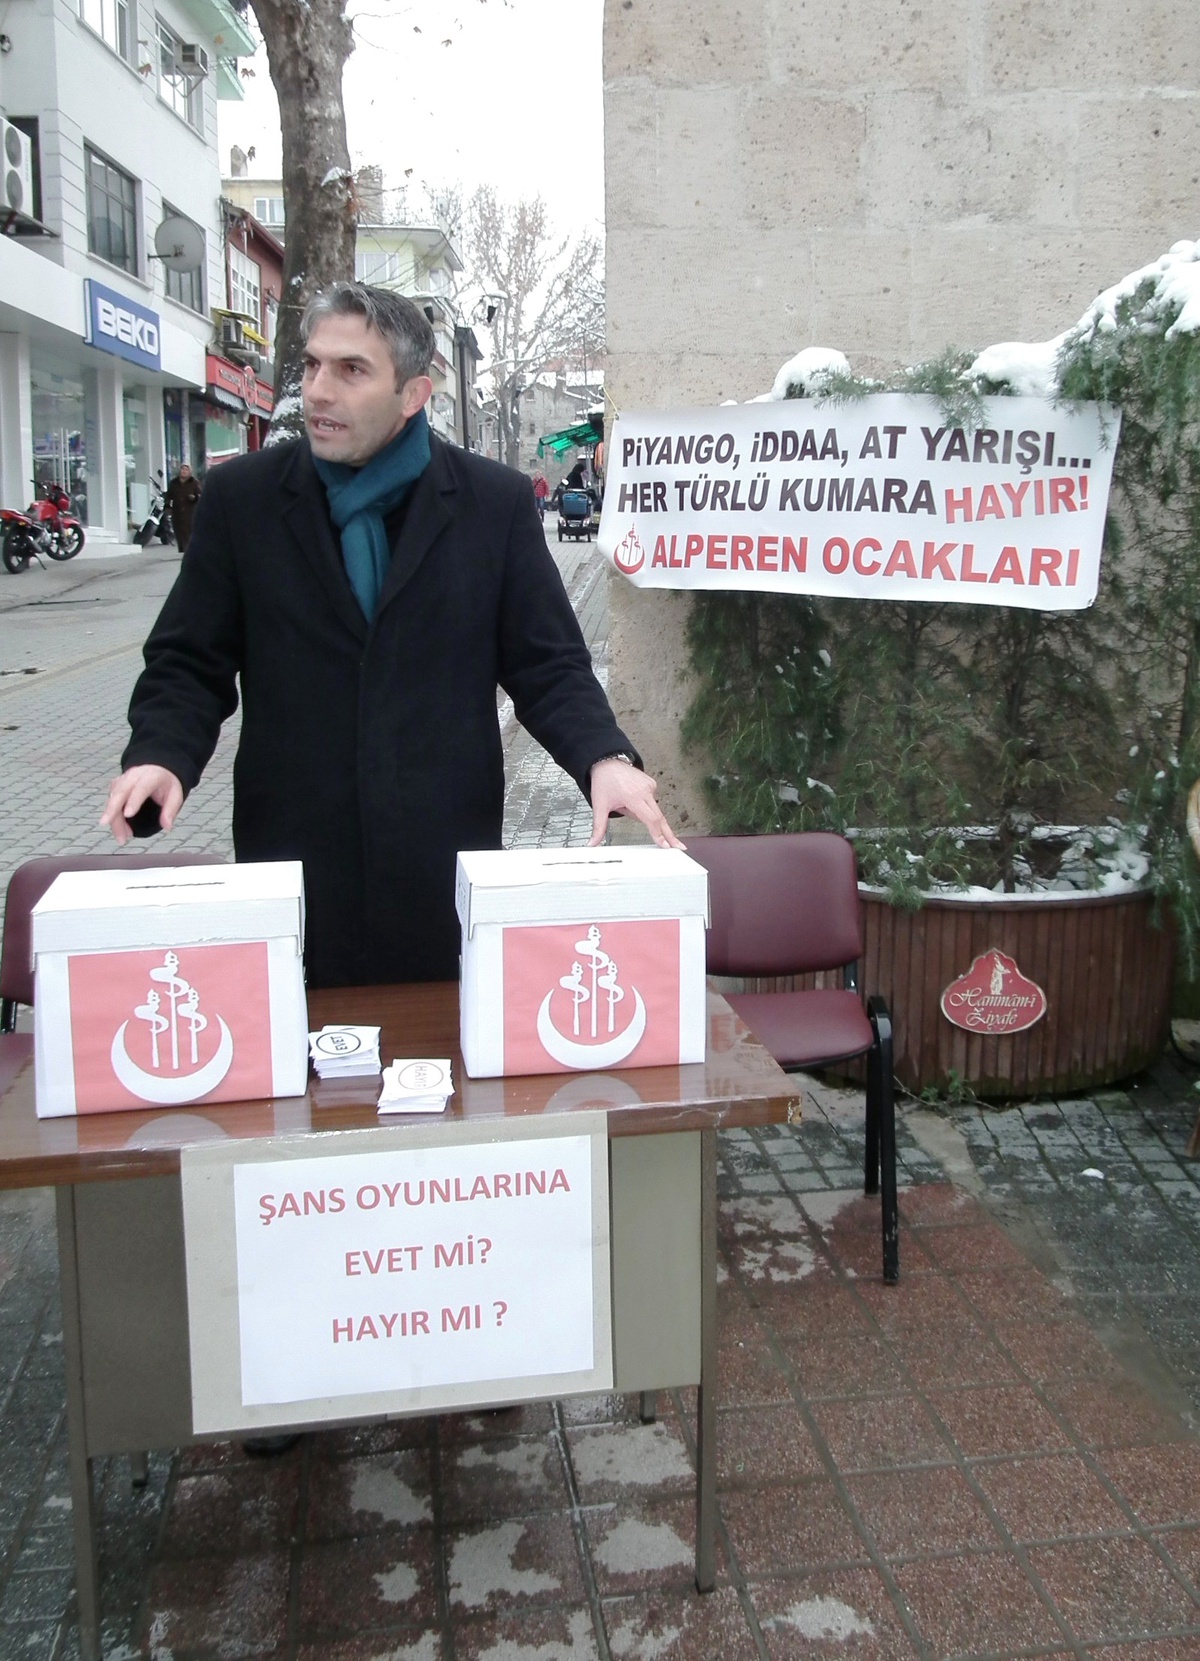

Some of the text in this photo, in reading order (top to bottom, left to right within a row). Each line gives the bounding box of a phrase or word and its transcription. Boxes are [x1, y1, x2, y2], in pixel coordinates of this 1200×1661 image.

[97, 297, 159, 356] BEKO
[858, 426, 907, 459] AT
[920, 427, 1092, 475] YARIŞI...
[617, 472, 1089, 524] HER TÜRLÜ KUMARA HAYIR!
[651, 534, 1081, 587] ALPEREN OCAKLARI
[330, 1036, 348, 1051] EVET
[258, 1168, 571, 1225] ŞANS OYUNLARINA
[345, 1235, 493, 1276] EVET Mİ?
[332, 1311, 430, 1343] HAYIR
[441, 1304, 481, 1332] MI
